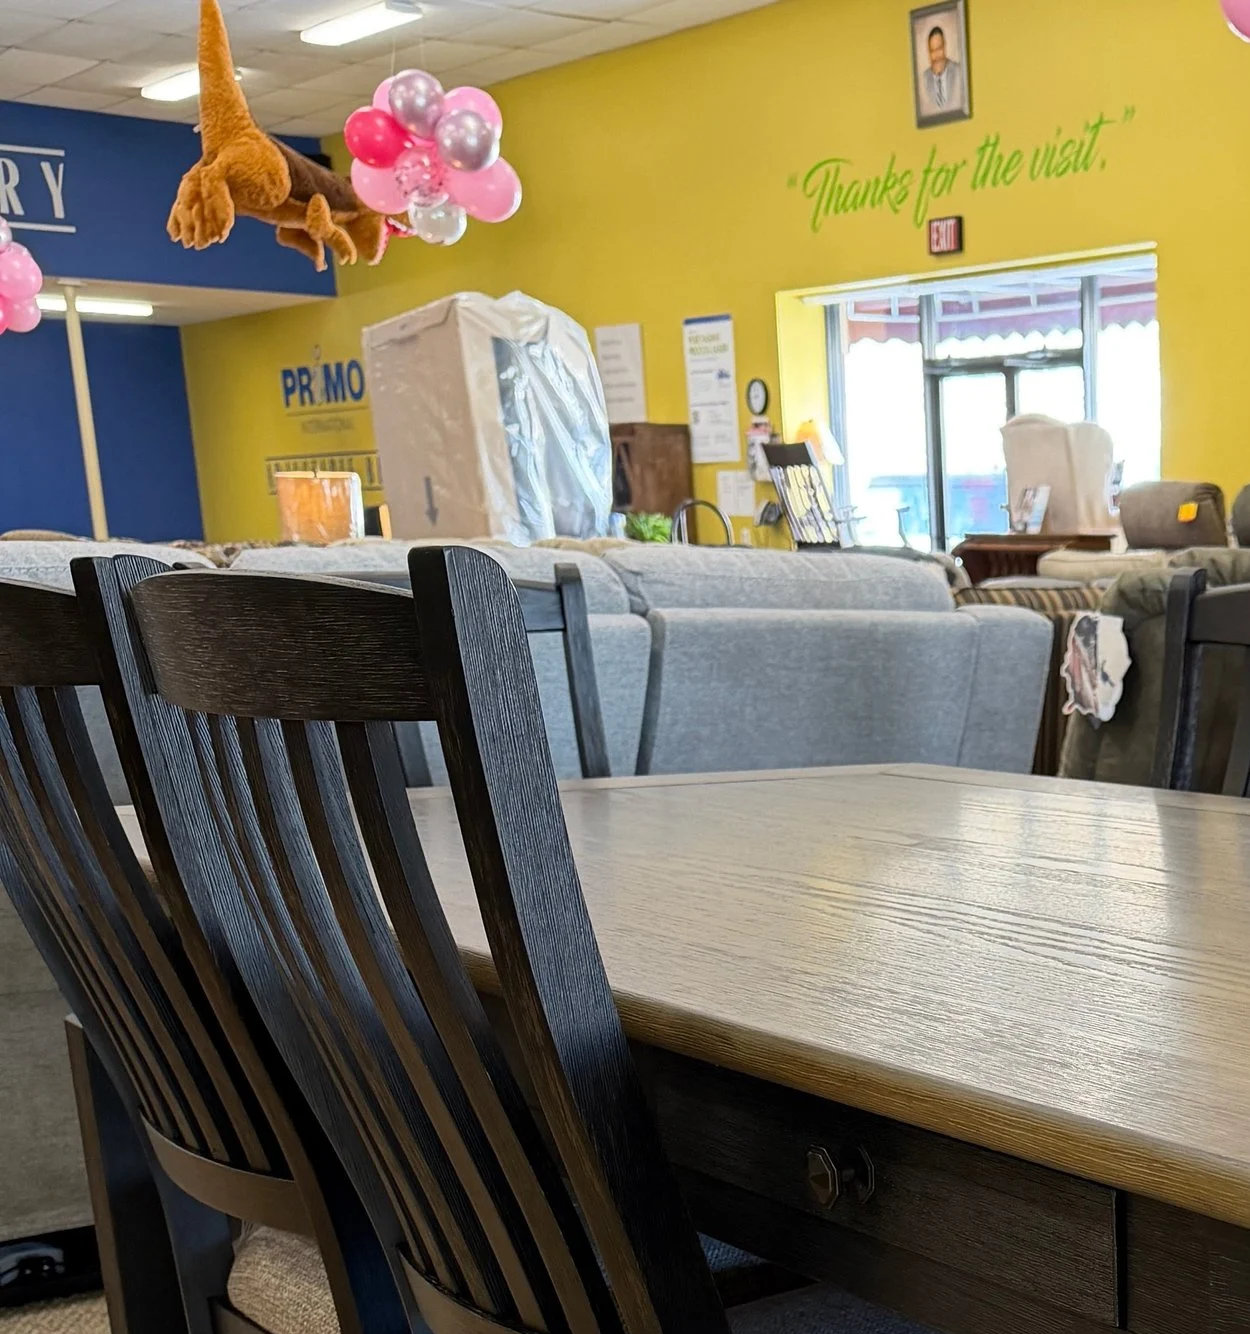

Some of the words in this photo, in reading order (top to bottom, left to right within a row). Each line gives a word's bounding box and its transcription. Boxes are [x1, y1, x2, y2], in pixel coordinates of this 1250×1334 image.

[912, 145, 967, 229] for
[970, 131, 1025, 191] the
[930, 218, 957, 253] EXIT
